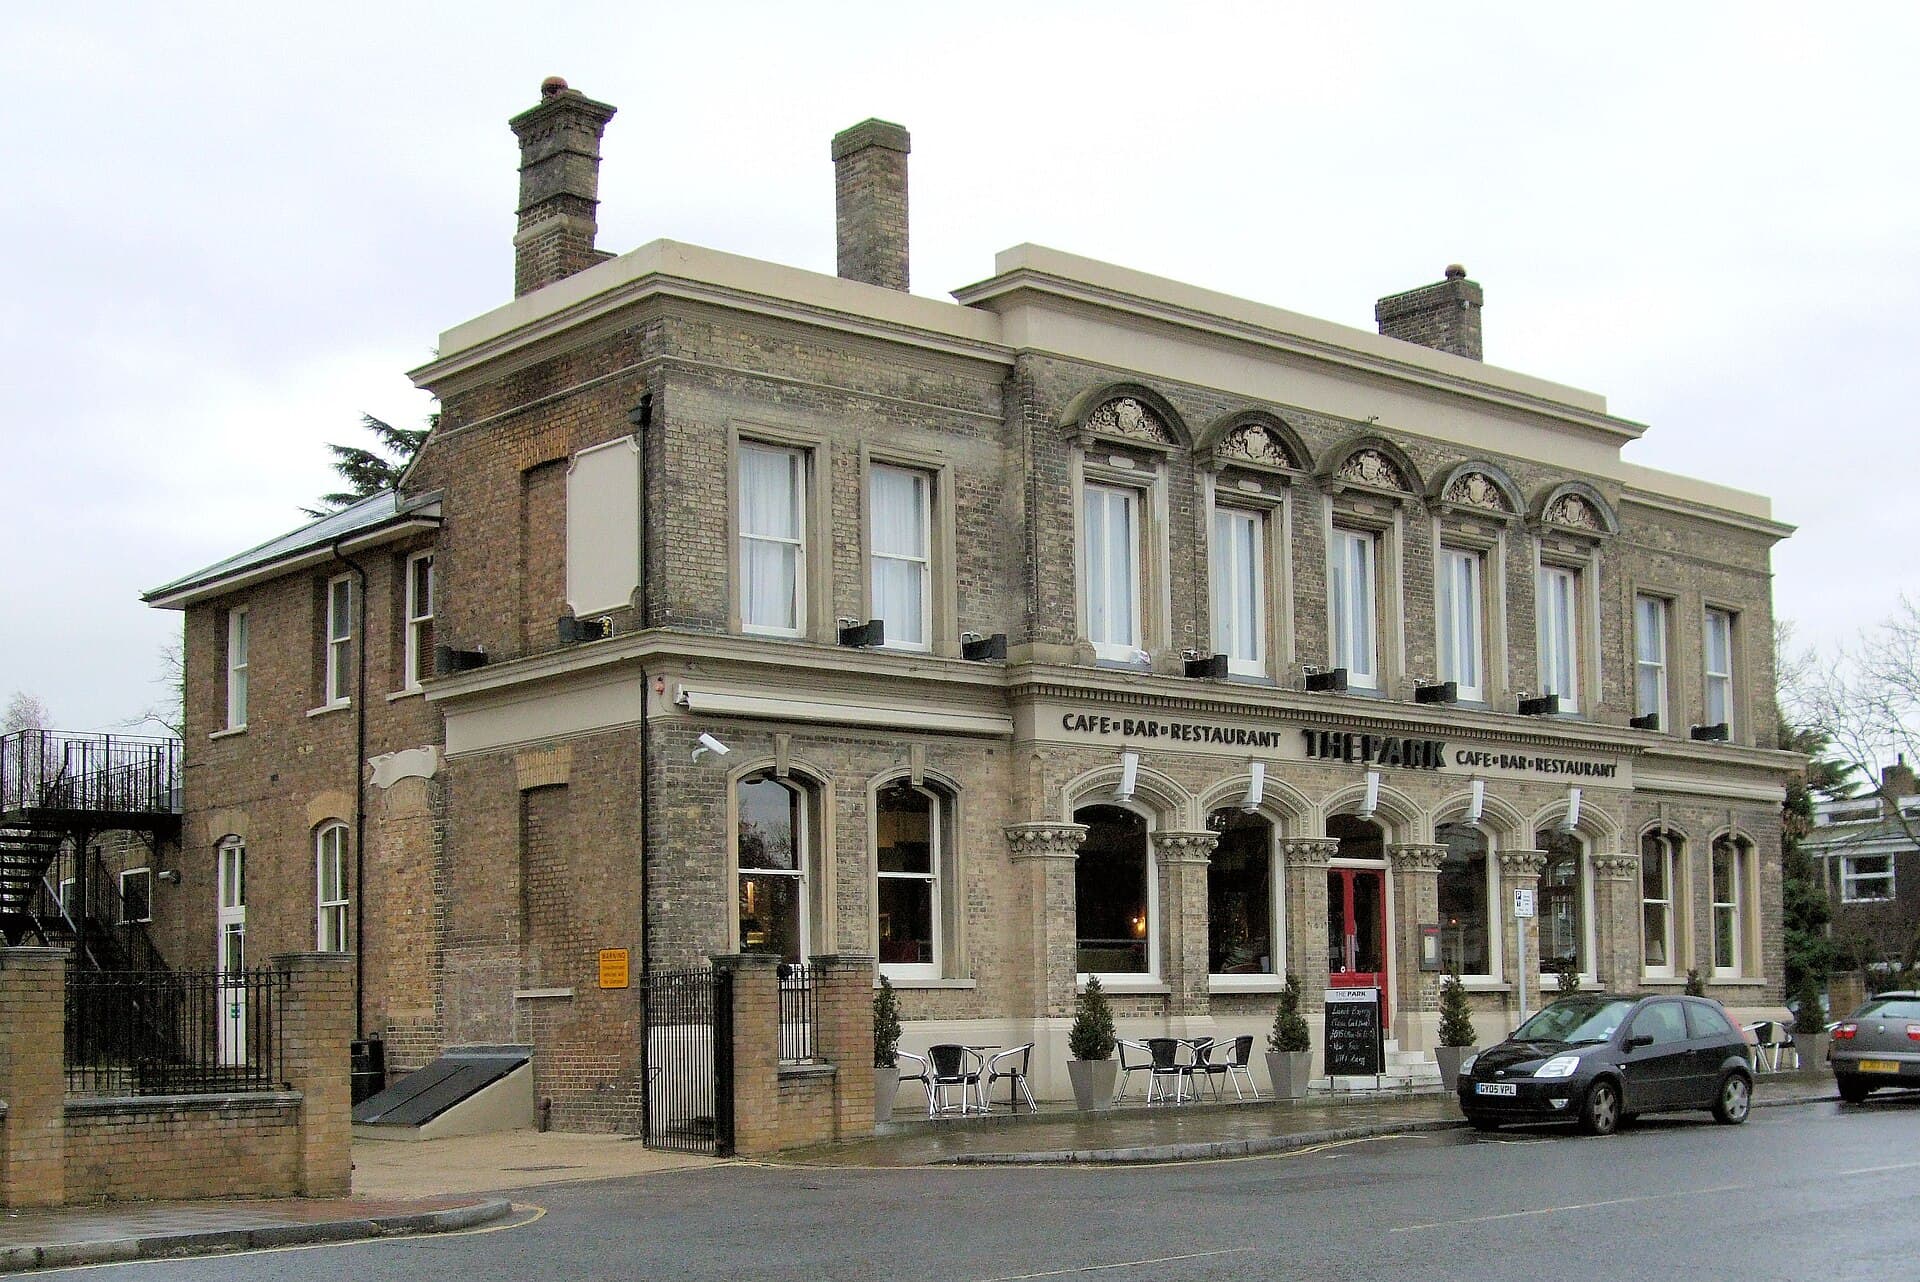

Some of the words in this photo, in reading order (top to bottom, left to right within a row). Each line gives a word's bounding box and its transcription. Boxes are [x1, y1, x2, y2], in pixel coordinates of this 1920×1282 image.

[1062, 713, 1111, 734] CAFE
[1123, 718, 1159, 738] BAR
[1170, 723, 1281, 748] RESTAURANT
[1302, 729, 1361, 763] THE
[1361, 733, 1447, 771] PARK
[1456, 750, 1492, 768] CAFE
[1500, 753, 1526, 770] BAR
[1535, 757, 1618, 778] RESTAURANT
